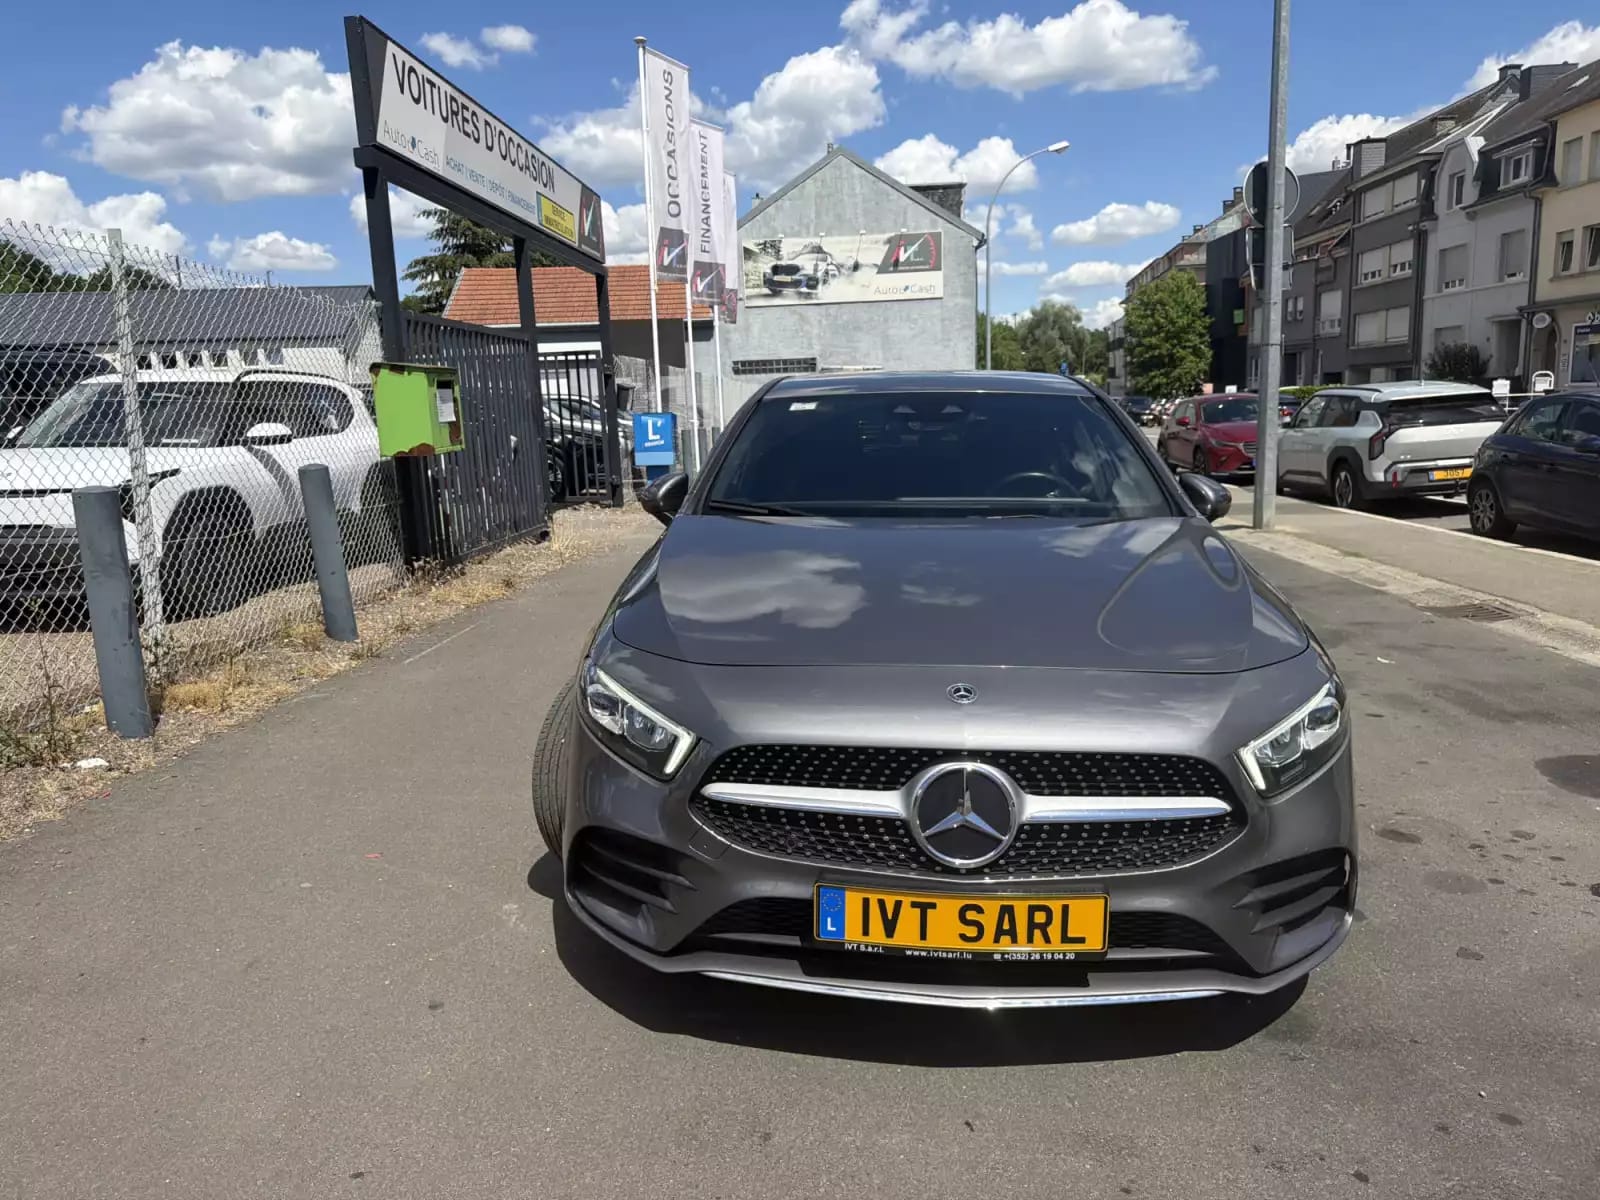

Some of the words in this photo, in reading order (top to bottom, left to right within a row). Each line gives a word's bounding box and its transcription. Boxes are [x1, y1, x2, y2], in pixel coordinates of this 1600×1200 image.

[392, 53, 480, 144] VOITURES
[485, 119, 555, 193] D'OCCASION
[663, 69, 681, 219] OCCASIONS
[446, 155, 464, 175] ACHAT
[699, 129, 711, 253] FINANCEMENT
[827, 917, 837, 931] L
[861, 897, 937, 941] IVT
[958, 903, 1086, 944] SARL
[844, 943, 858, 951] IVT
[905, 949, 972, 960] www.ivtsarl.lu
[1004, 952, 1029, 960] +(352)
